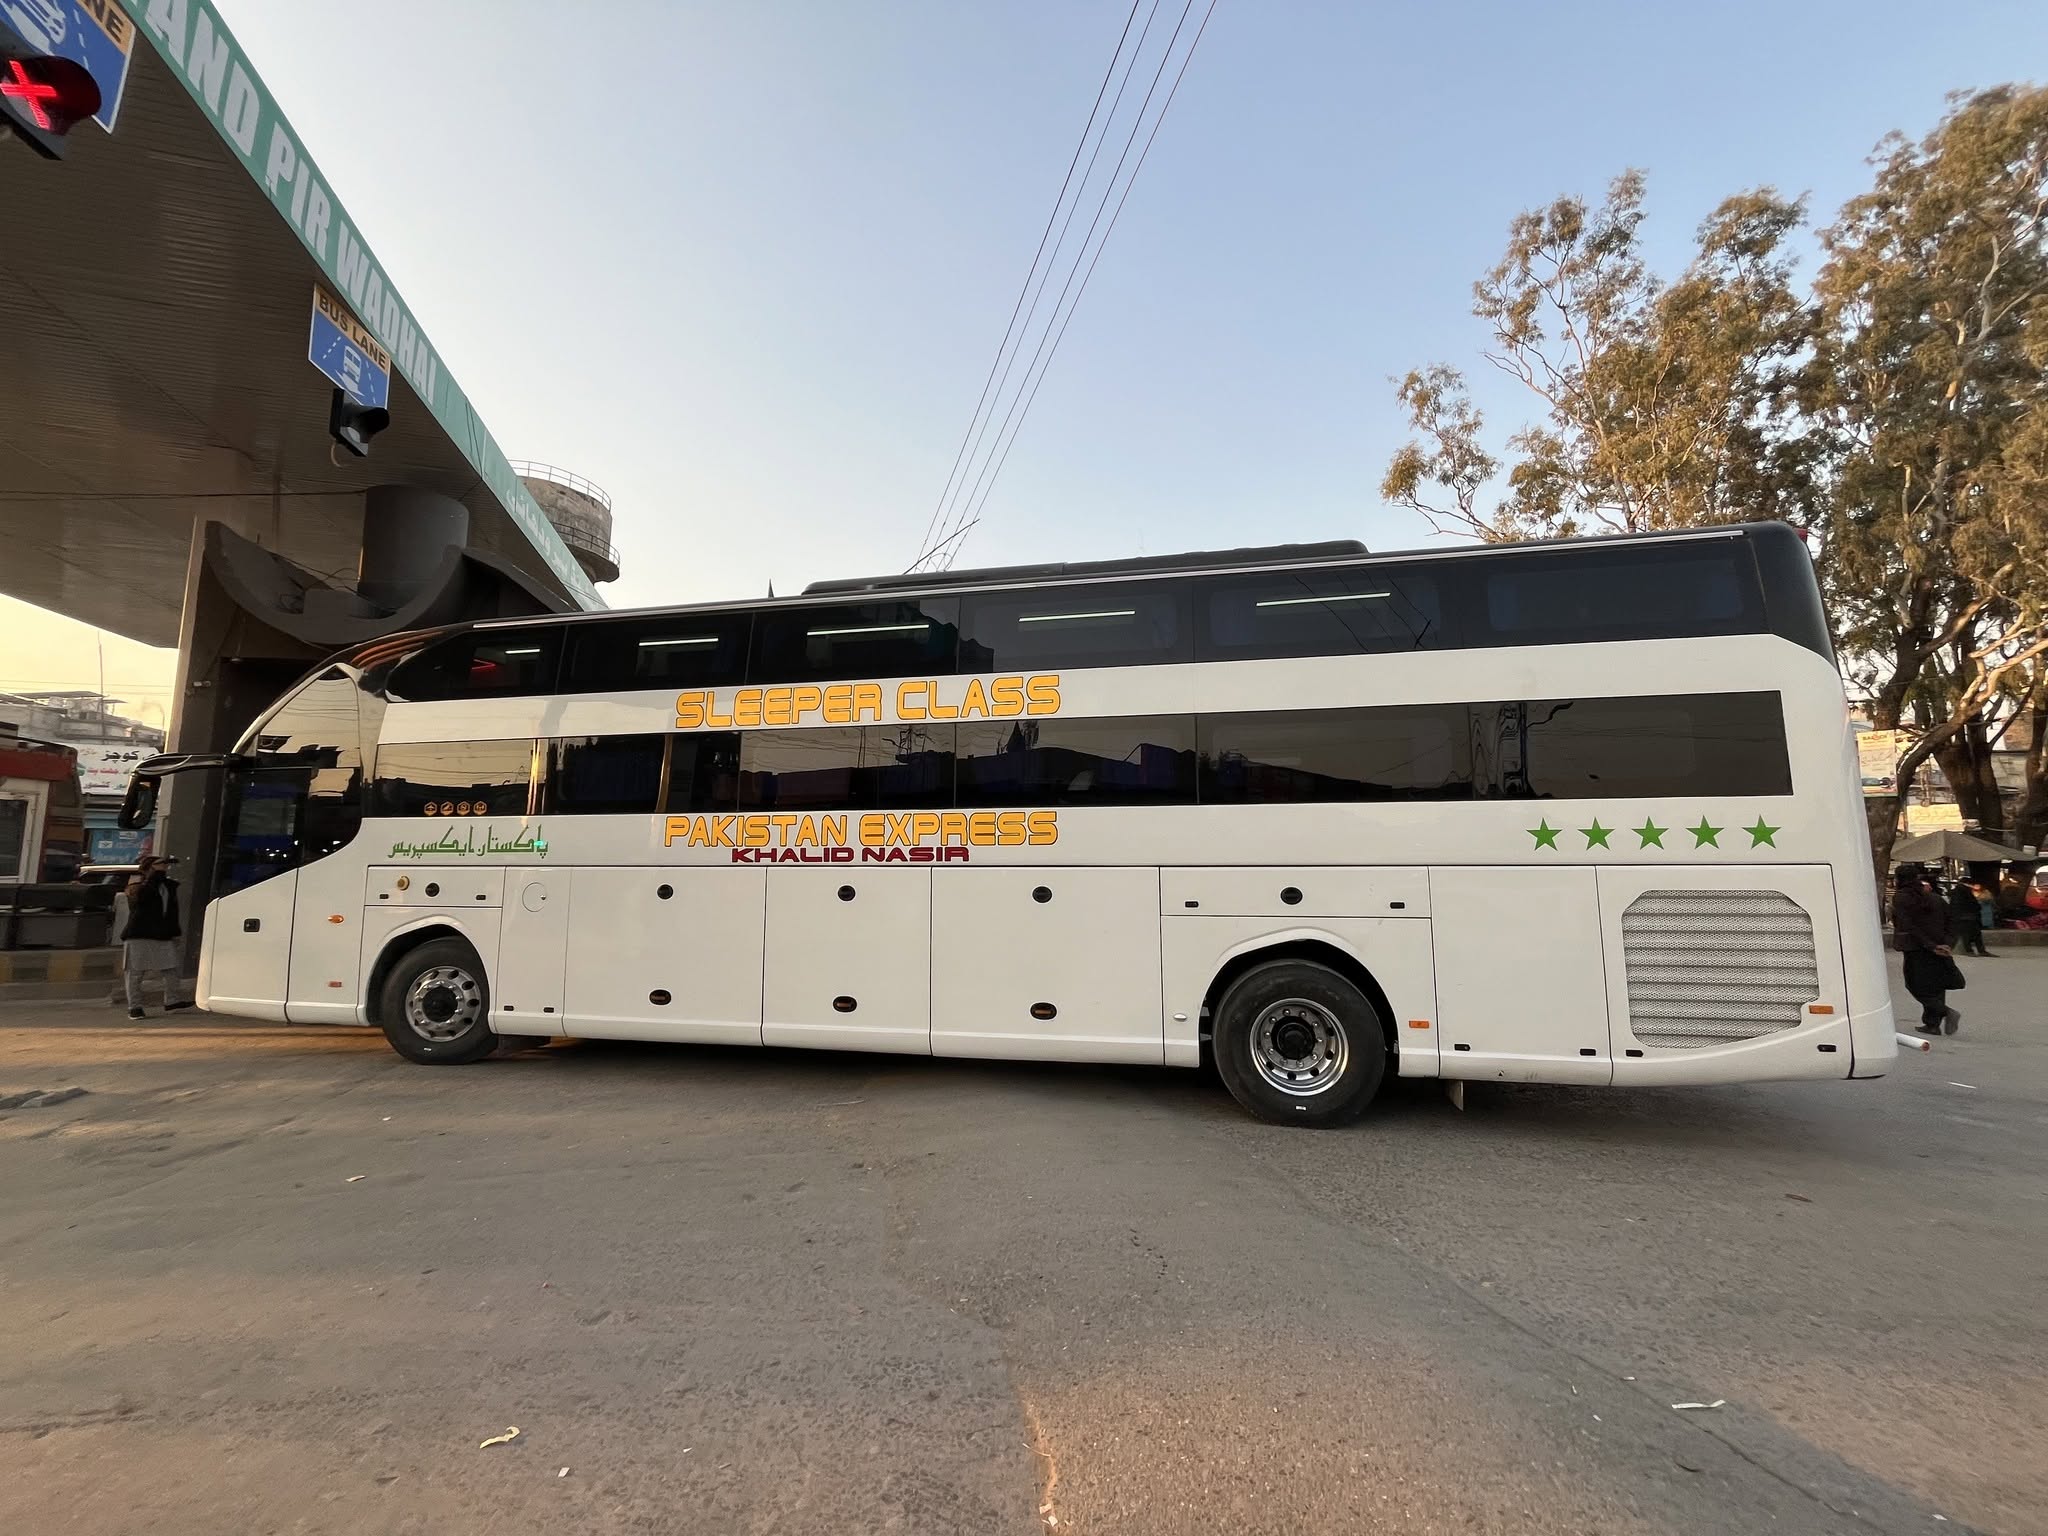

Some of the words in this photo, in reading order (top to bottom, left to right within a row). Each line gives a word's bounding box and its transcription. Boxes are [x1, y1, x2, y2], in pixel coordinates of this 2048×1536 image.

[131, 0, 260, 157] AND
[266, 121, 333, 261] PIR
[336, 221, 437, 407] WADHAI
[319, 294, 348, 331] BUS
[352, 321, 386, 370] LANE
[675, 683, 882, 728] SLEEPER
[896, 675, 1060, 721] CLASS
[387, 824, 475, 859] ایکسپریس
[476, 824, 549, 859] پاکستان
[664, 814, 848, 847] PAKISTAN
[858, 811, 1058, 846] EXPRESS
[732, 847, 855, 863] KHALID
[862, 846, 970, 862] NASIR
